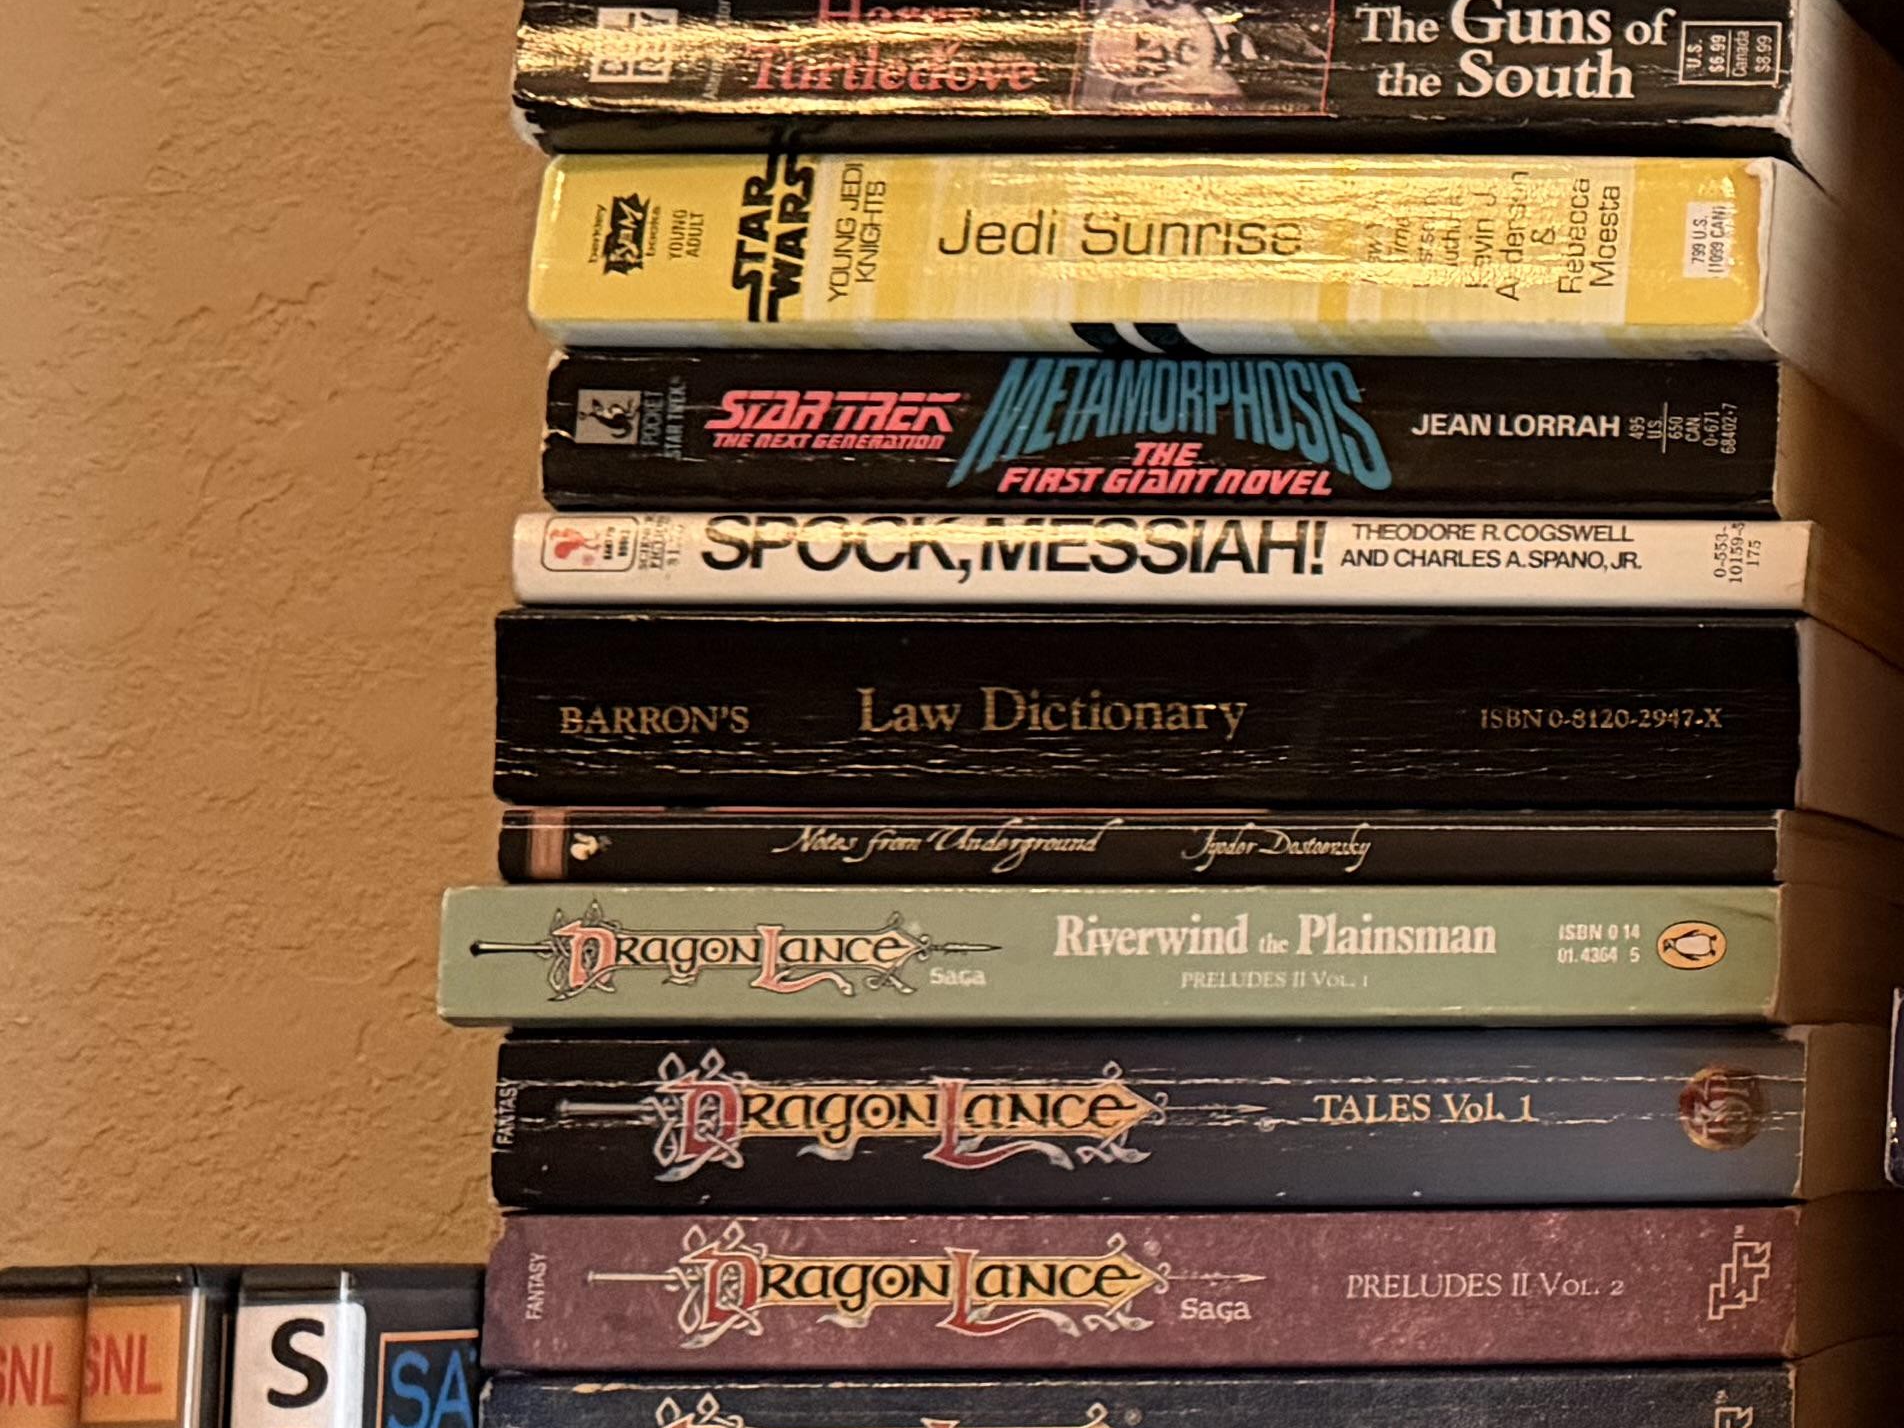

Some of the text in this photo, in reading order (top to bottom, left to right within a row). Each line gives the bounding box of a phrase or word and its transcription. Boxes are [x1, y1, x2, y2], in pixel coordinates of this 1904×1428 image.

[1356, 6, 1440, 44] The
[1625, 8, 1676, 46] of
[1377, 50, 1634, 100] the South
[1686, 40, 1704, 72] U.S.
[1710, 33, 1726, 74] $6.99
[1732, 30, 1751, 78] Canada
[1757, 34, 1774, 73] $8.99
[560, 686, 1723, 742] BARRON'S Law Dictionary ISBN 0-8120-2947-X
[525, 1252, 547, 1320] FANTASY
